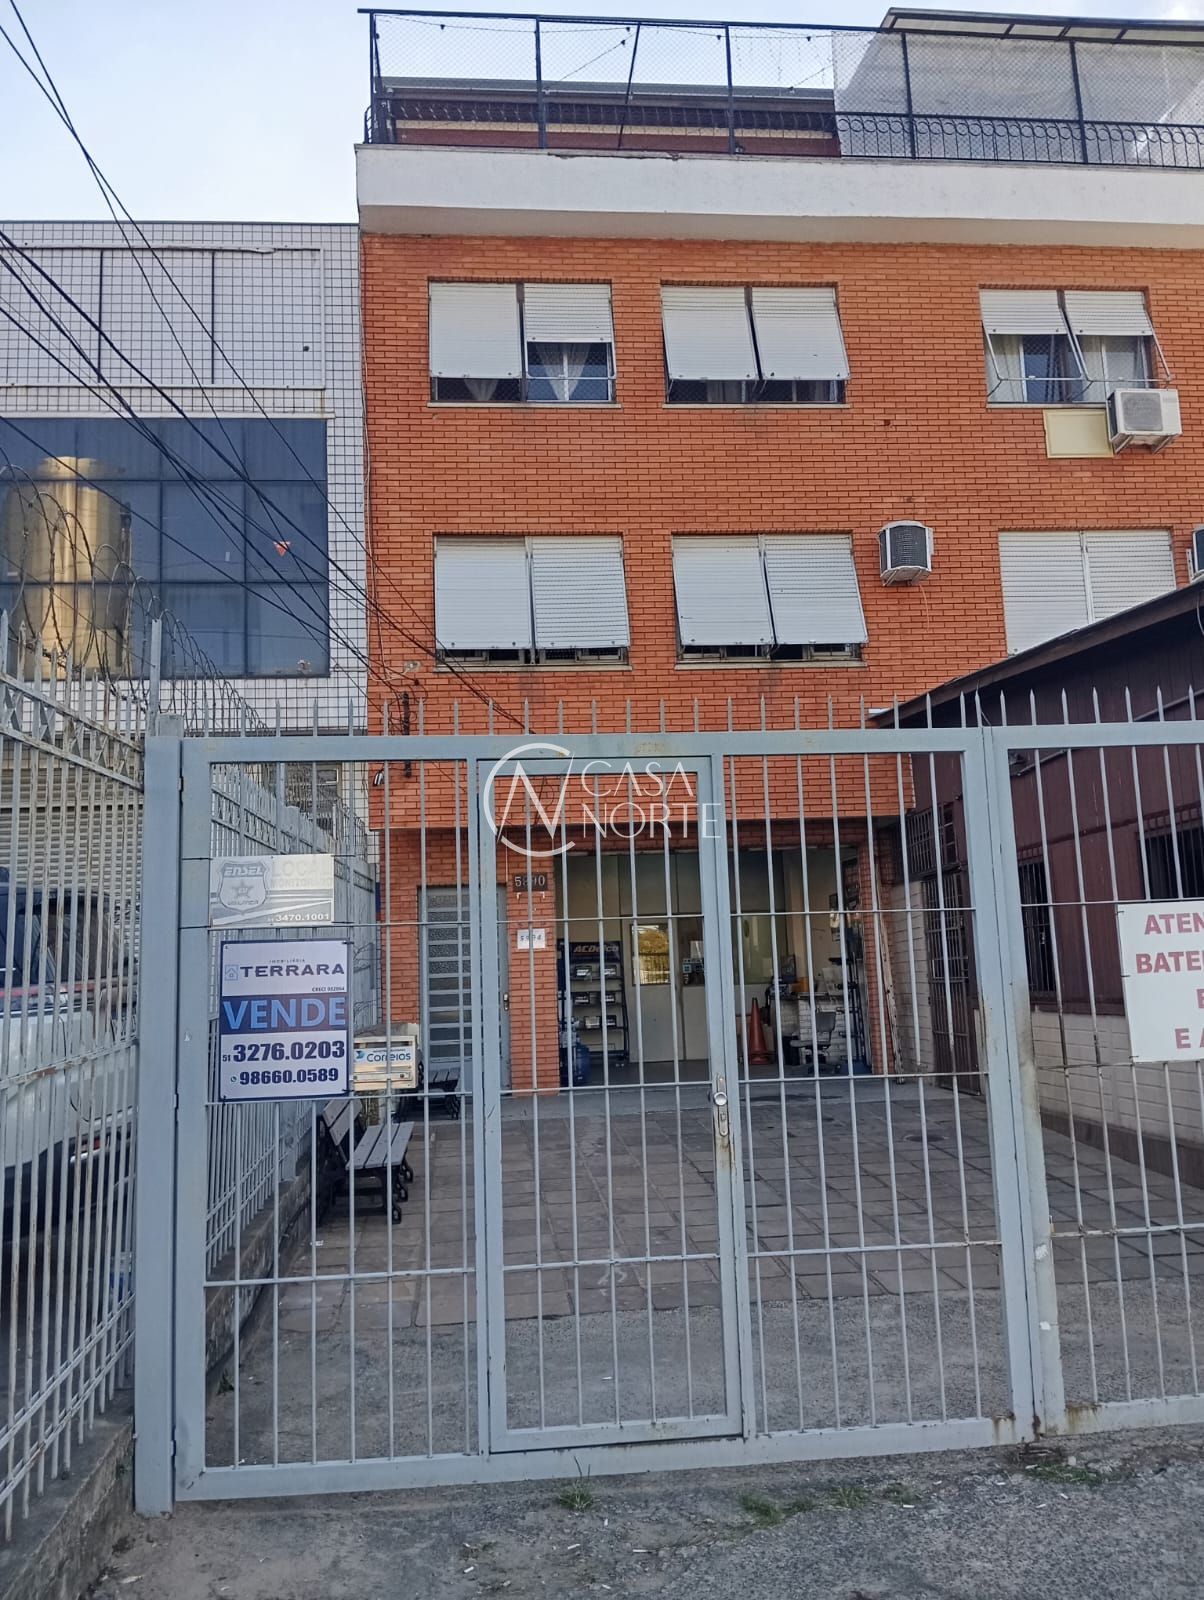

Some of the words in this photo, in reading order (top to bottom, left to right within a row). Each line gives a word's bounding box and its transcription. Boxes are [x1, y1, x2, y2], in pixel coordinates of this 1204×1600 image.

[224, 866, 263, 876] ENSEL
[275, 913, 330, 922] 3470.1001
[239, 964, 345, 977] TERRARA
[1136, 951, 1204, 974] BATE
[224, 997, 346, 1030] VENDE
[222, 1053, 232, 1063] 51
[233, 1040, 345, 1062] 3276.0203
[239, 1067, 339, 1086] 98660.0589
